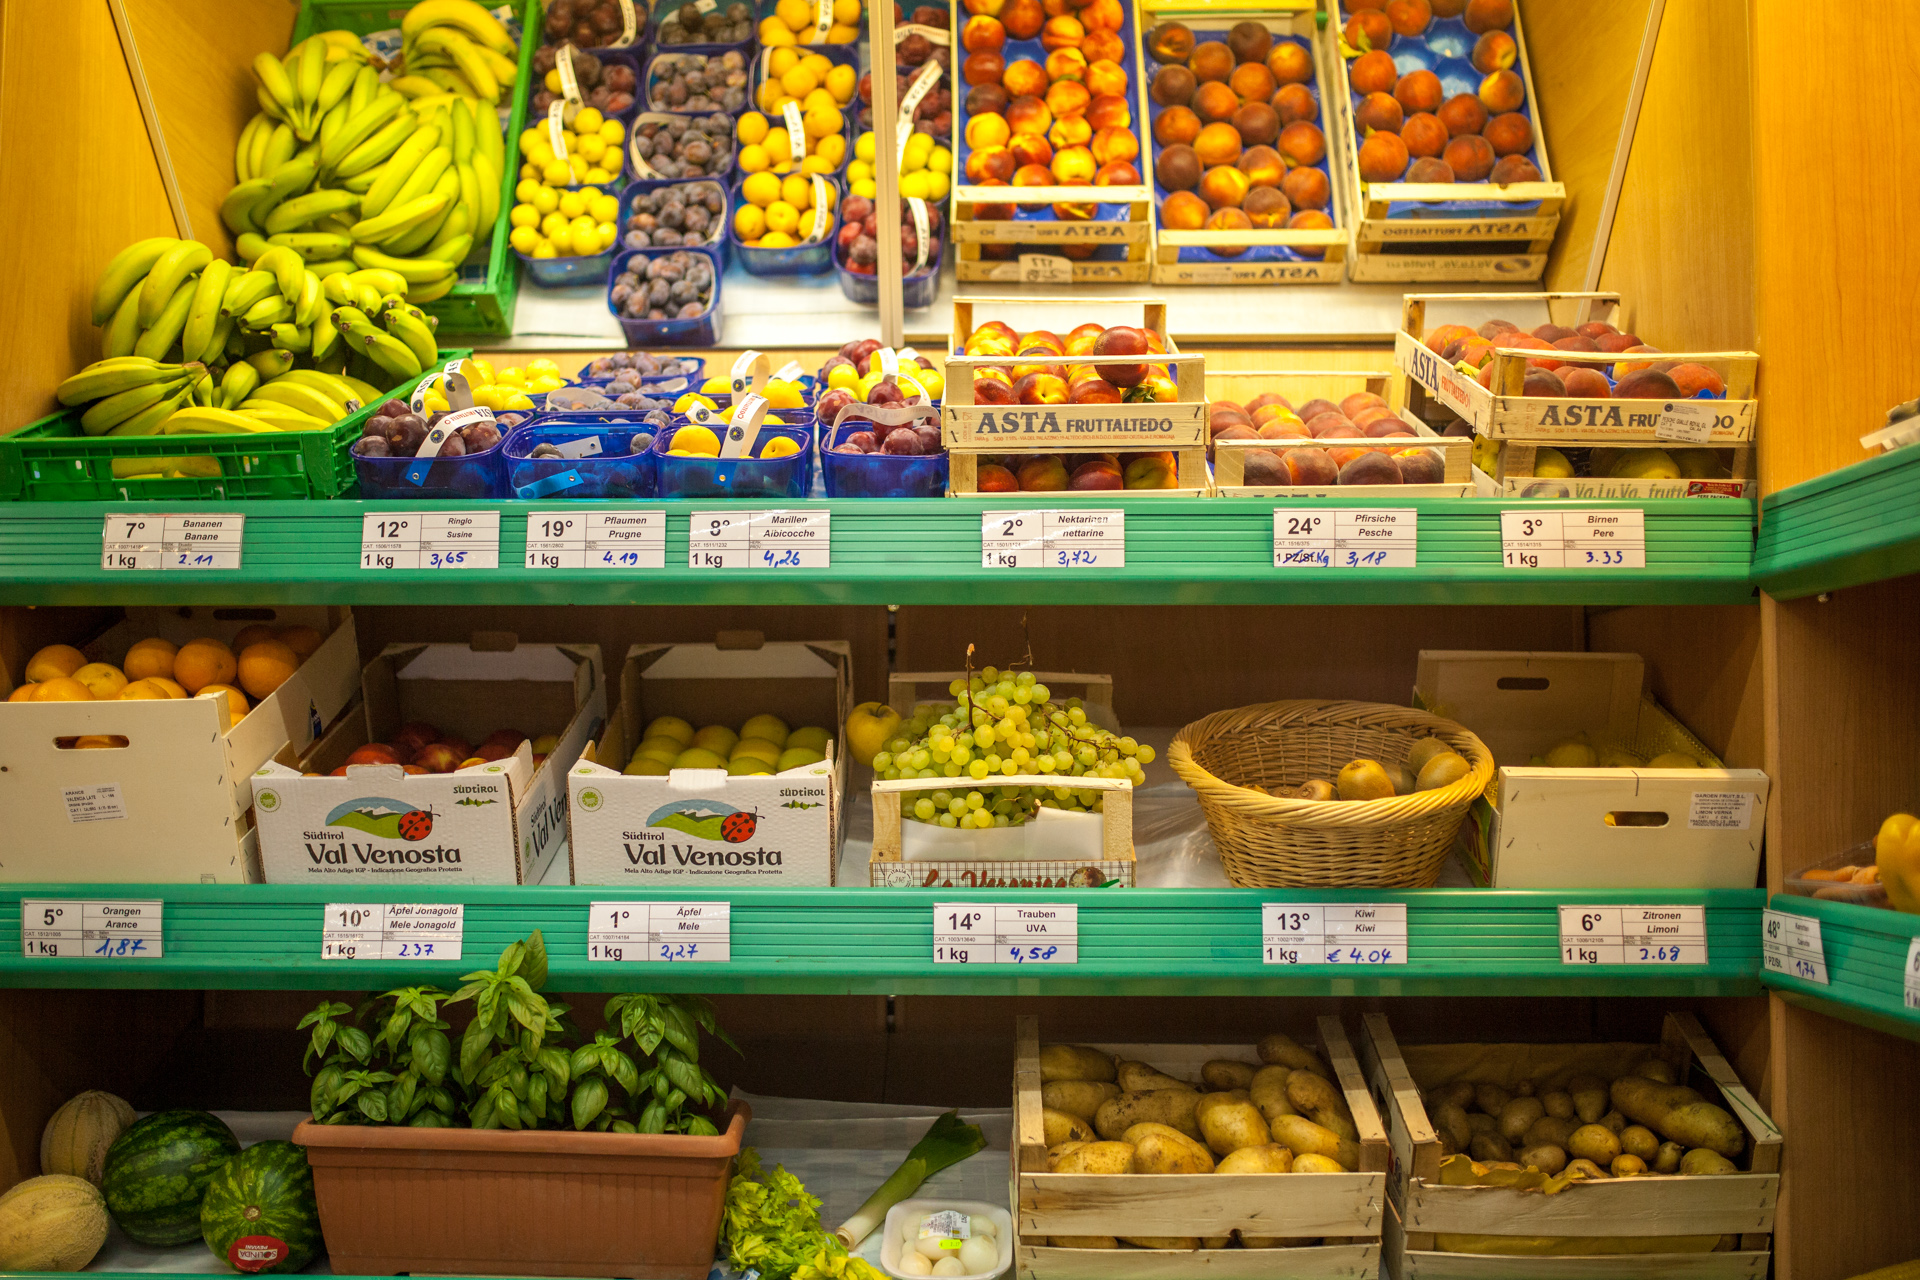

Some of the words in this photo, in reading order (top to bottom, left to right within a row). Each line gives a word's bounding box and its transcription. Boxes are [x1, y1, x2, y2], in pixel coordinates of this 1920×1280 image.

[1412, 348, 1438, 391] ASTA
[976, 412, 1061, 433] ASTA
[1066, 418, 1172, 432] FRUTTALTEDO
[1539, 405, 1623, 426] ASTA
[126, 523, 145, 538] 7°
[183, 520, 222, 528] Bananen
[378, 521, 408, 537] 12°
[542, 521, 572, 537] 19°
[1003, 520, 1023, 536] 2°
[1288, 518, 1321, 534] 24°
[1523, 520, 1542, 536] 3°
[609, 531, 641, 539] Prugne
[1063, 529, 1104, 537] nettarine
[108, 554, 112, 565] 1
[119, 554, 136, 568] kg
[364, 554, 370, 565] 1
[377, 554, 394, 569] kg
[430, 552, 468, 569] 3,65
[529, 554, 535, 565] 1
[542, 554, 559, 568] kg
[603, 551, 638, 565] 4.19
[693, 553, 699, 565] 1
[706, 553, 722, 568] kg
[764, 550, 800, 568] 4,26
[999, 553, 1016, 567] kg
[1276, 553, 1281, 562] 1
[1346, 552, 1386, 567] 3,18
[1507, 553, 1513, 564] 1
[1520, 553, 1537, 567] kg
[303, 831, 344, 840] Südtirol
[532, 811, 548, 858] Val
[623, 832, 664, 840] Südtirol
[305, 843, 347, 864] Val
[352, 844, 461, 864] Venosta
[623, 844, 666, 865] Val
[672, 845, 782, 865] Venosta
[44, 909, 63, 925] 5°
[103, 907, 141, 916] Orangen
[389, 905, 413, 914] Äpfel
[416, 907, 458, 916] Jonagold
[677, 907, 701, 916] Äpfel
[1017, 910, 1055, 918] Trauben
[339, 910, 370, 927] 10°
[413, 921, 456, 930] Jonagold
[611, 911, 629, 928] 1°
[949, 913, 981, 930] 14°
[1278, 913, 1310, 930] 13°
[1582, 914, 1601, 931] 6°
[1355, 924, 1375, 932] Kiwi
[1647, 925, 1679, 933] Limoni
[28, 942, 33, 953] 1
[40, 942, 57, 956] kg
[95, 939, 147, 957] 1,87
[326, 945, 332, 955] 1
[339, 945, 355, 959] kg
[592, 946, 598, 957] 1
[605, 946, 622, 961] kg
[661, 944, 698, 961] 2,27
[937, 948, 943, 959] 1
[951, 948, 968, 963] kg
[1010, 946, 1057, 963] 4,58
[1267, 948, 1272, 960] 1
[1280, 948, 1297, 963] kg
[1566, 948, 1572, 960] 1
[1579, 948, 1597, 963] kg
